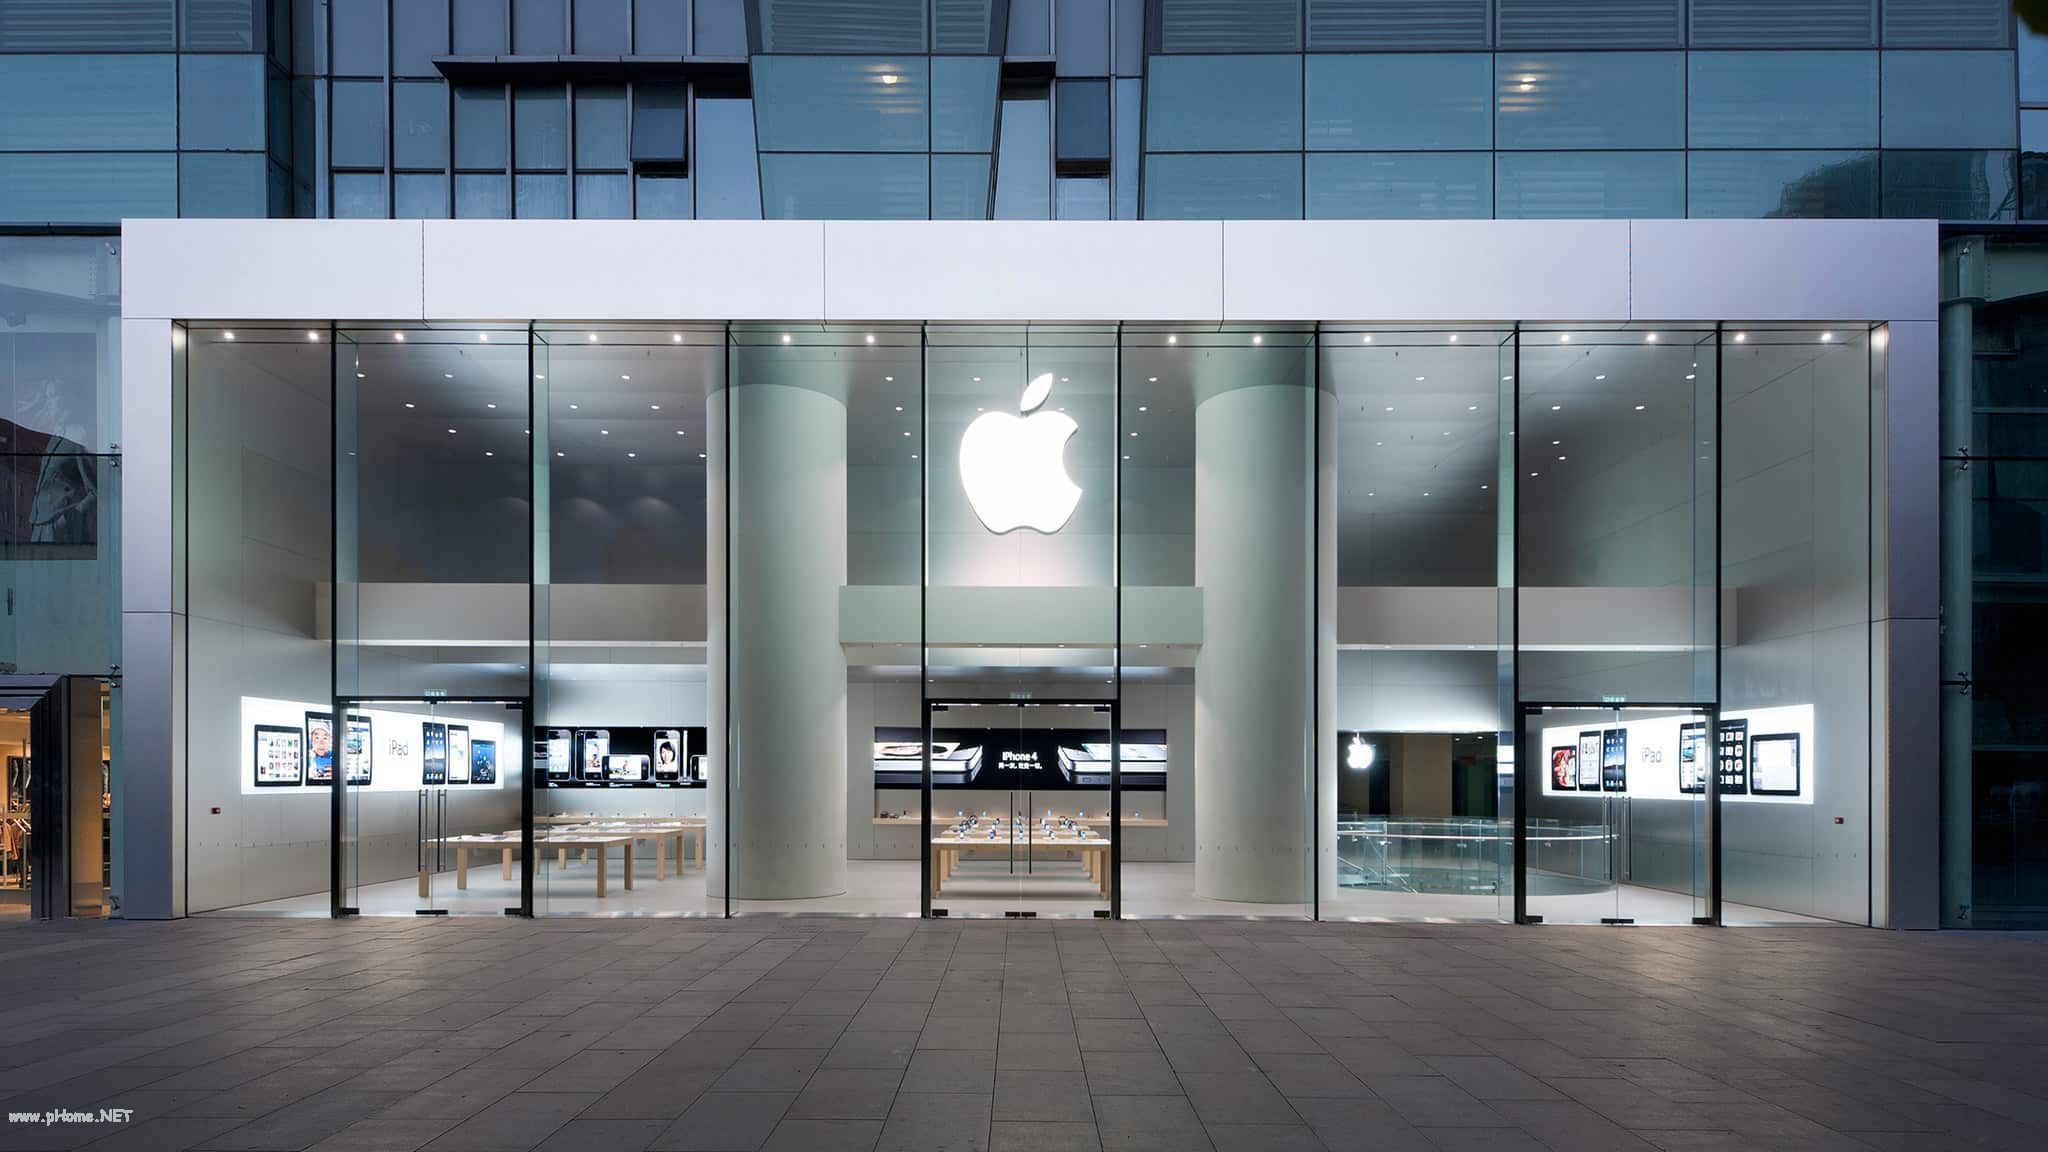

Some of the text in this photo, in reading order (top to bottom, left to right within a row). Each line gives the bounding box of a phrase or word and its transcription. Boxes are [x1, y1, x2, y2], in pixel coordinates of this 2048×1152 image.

[388, 738, 409, 756] iPad
[1002, 751, 1038, 761] iPhone 4
